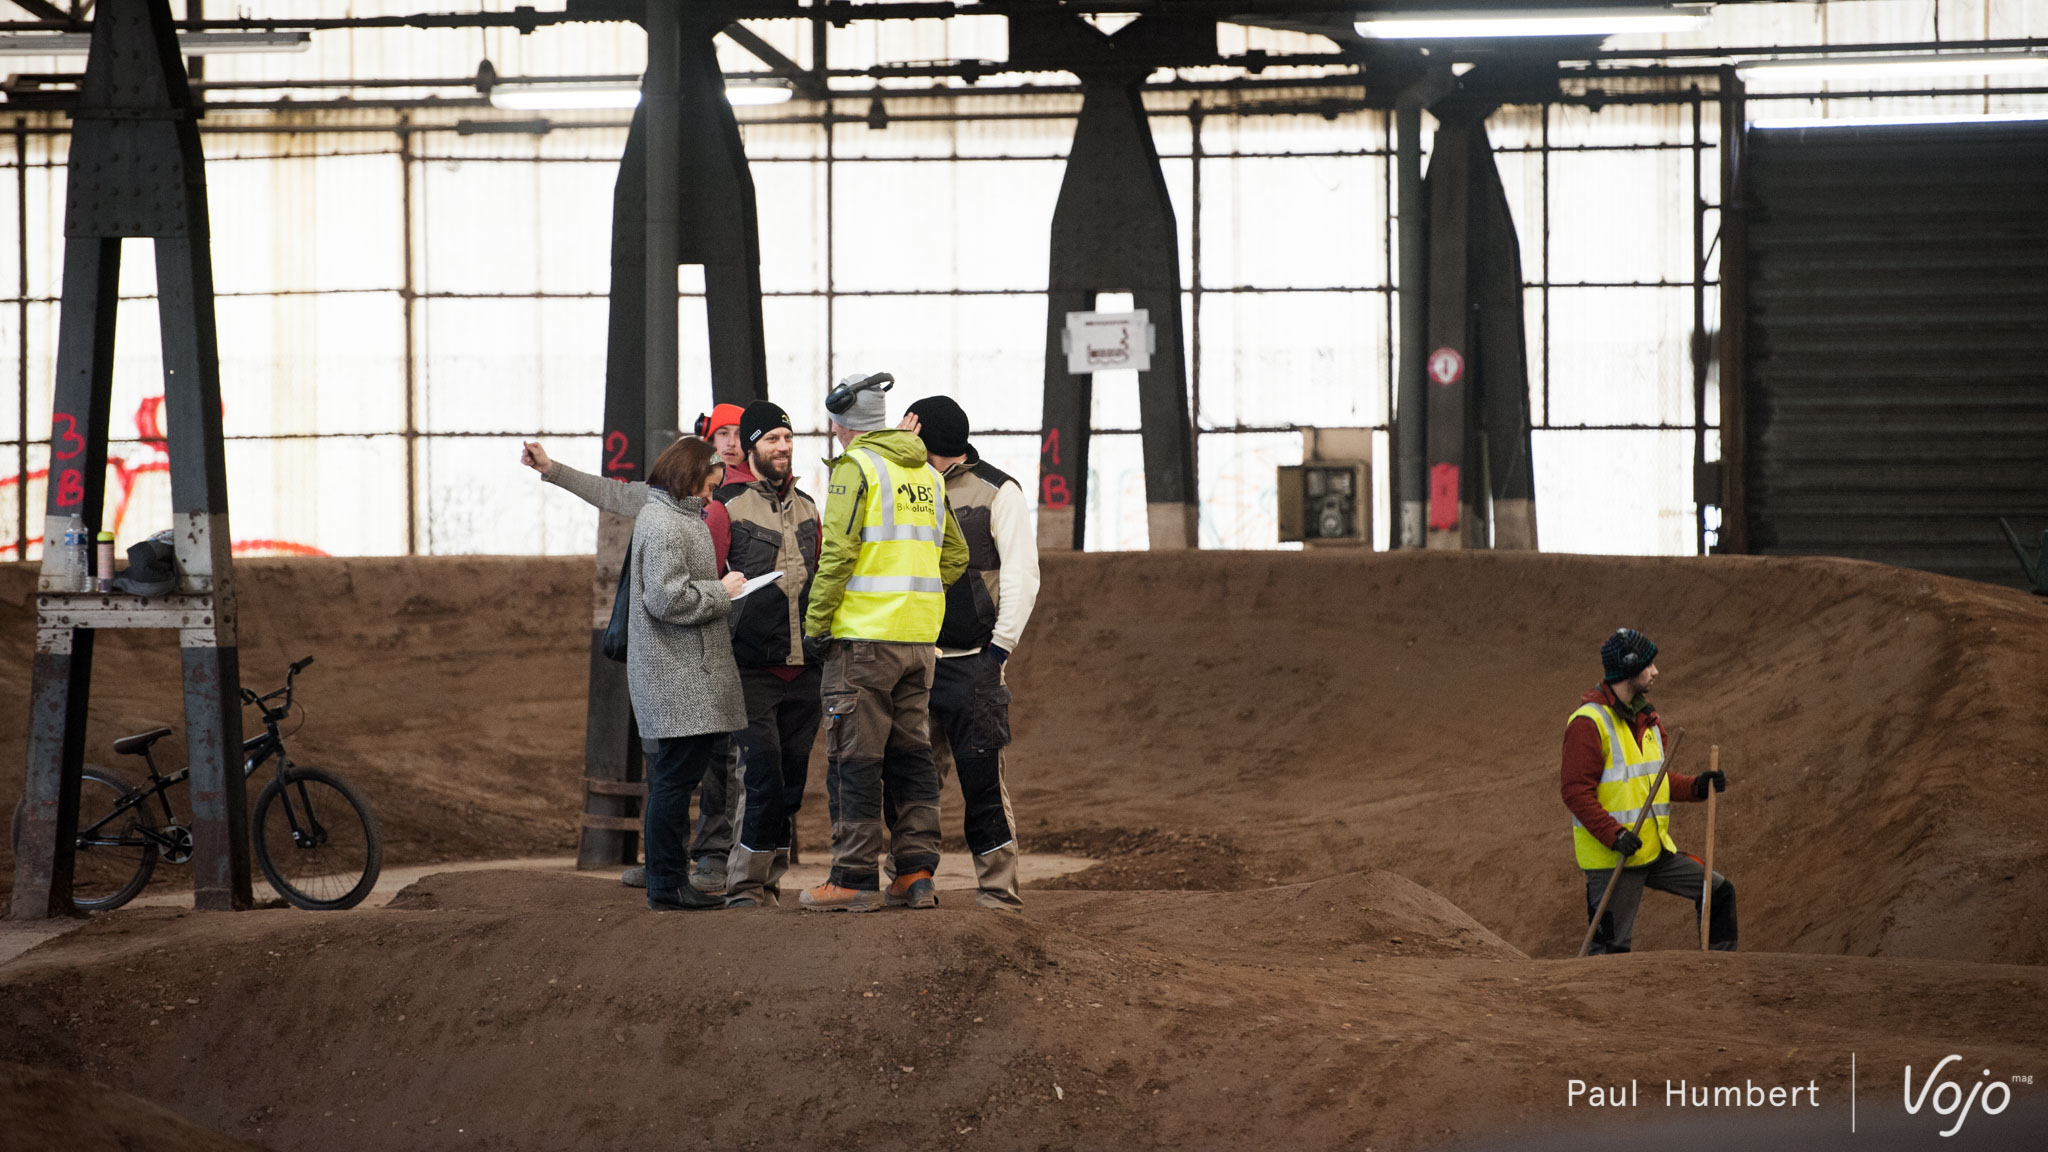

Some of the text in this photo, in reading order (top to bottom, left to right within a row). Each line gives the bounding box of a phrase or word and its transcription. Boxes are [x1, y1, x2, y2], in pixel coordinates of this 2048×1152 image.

[52, 412, 85, 460] 3
[605, 430, 635, 471] 2
[1041, 428, 1061, 465] 1
[56, 468, 84, 507] B
[1042, 474, 1071, 510] B
